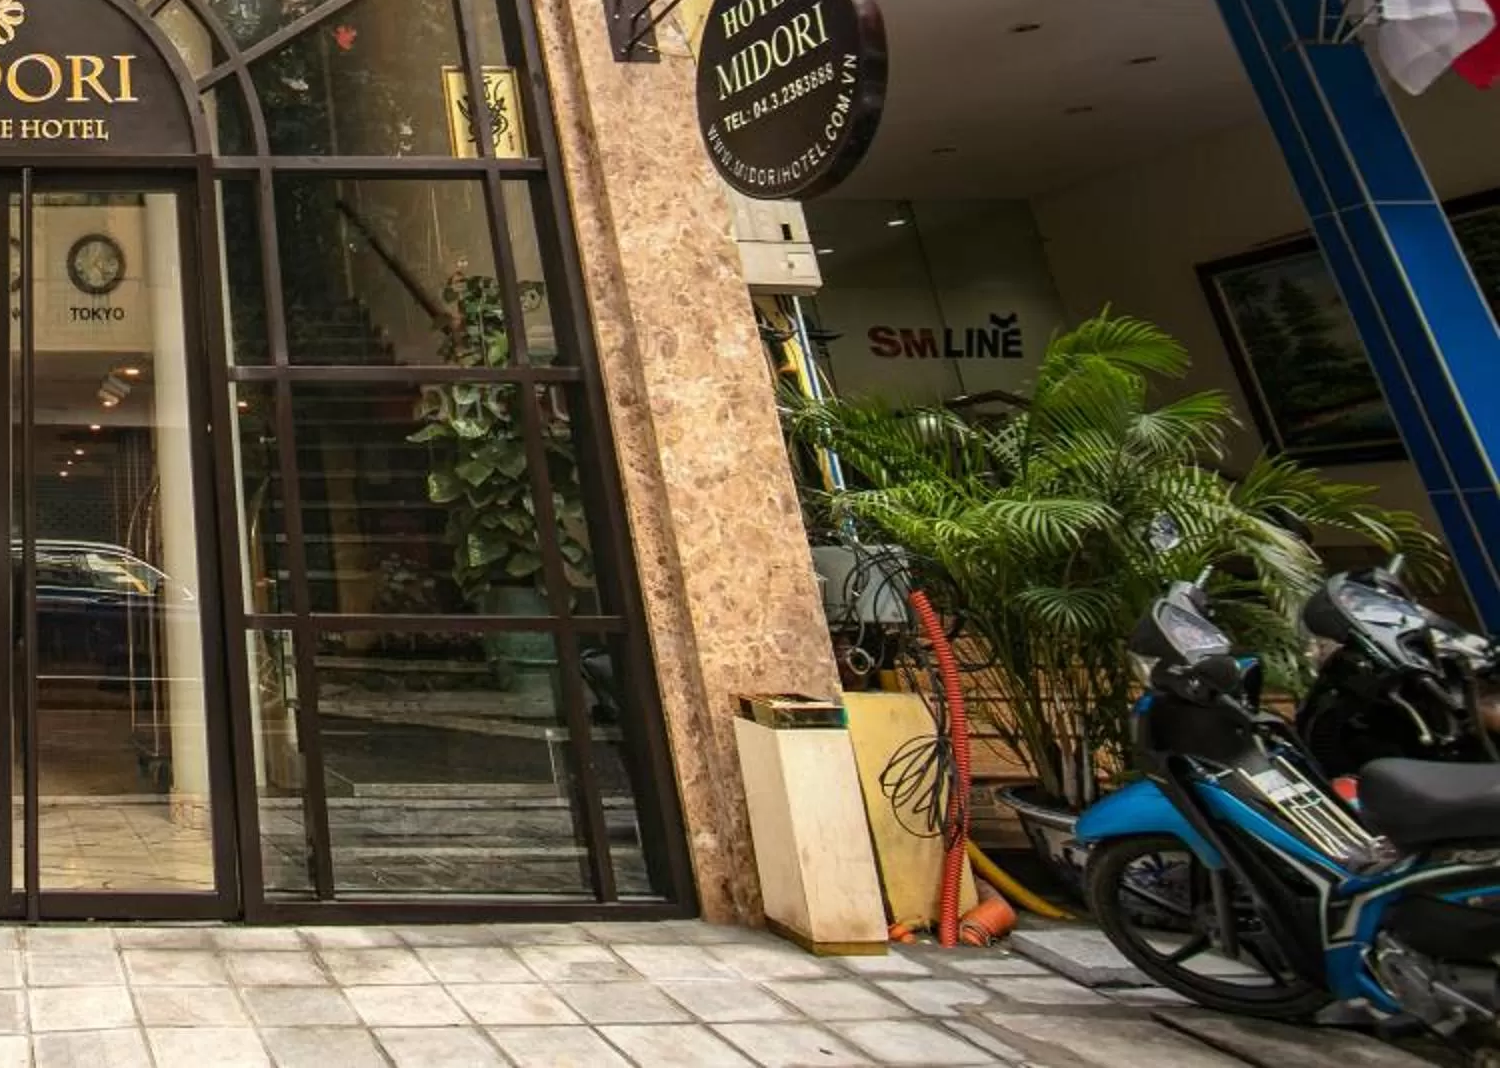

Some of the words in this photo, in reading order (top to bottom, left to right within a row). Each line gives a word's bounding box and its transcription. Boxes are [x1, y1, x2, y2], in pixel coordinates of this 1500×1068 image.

[714, 1, 831, 101] MIDORI
[21, 119, 109, 141] HOTEL
[723, 108, 752, 133] TEL:
[70, 307, 125, 321] TOKYO
